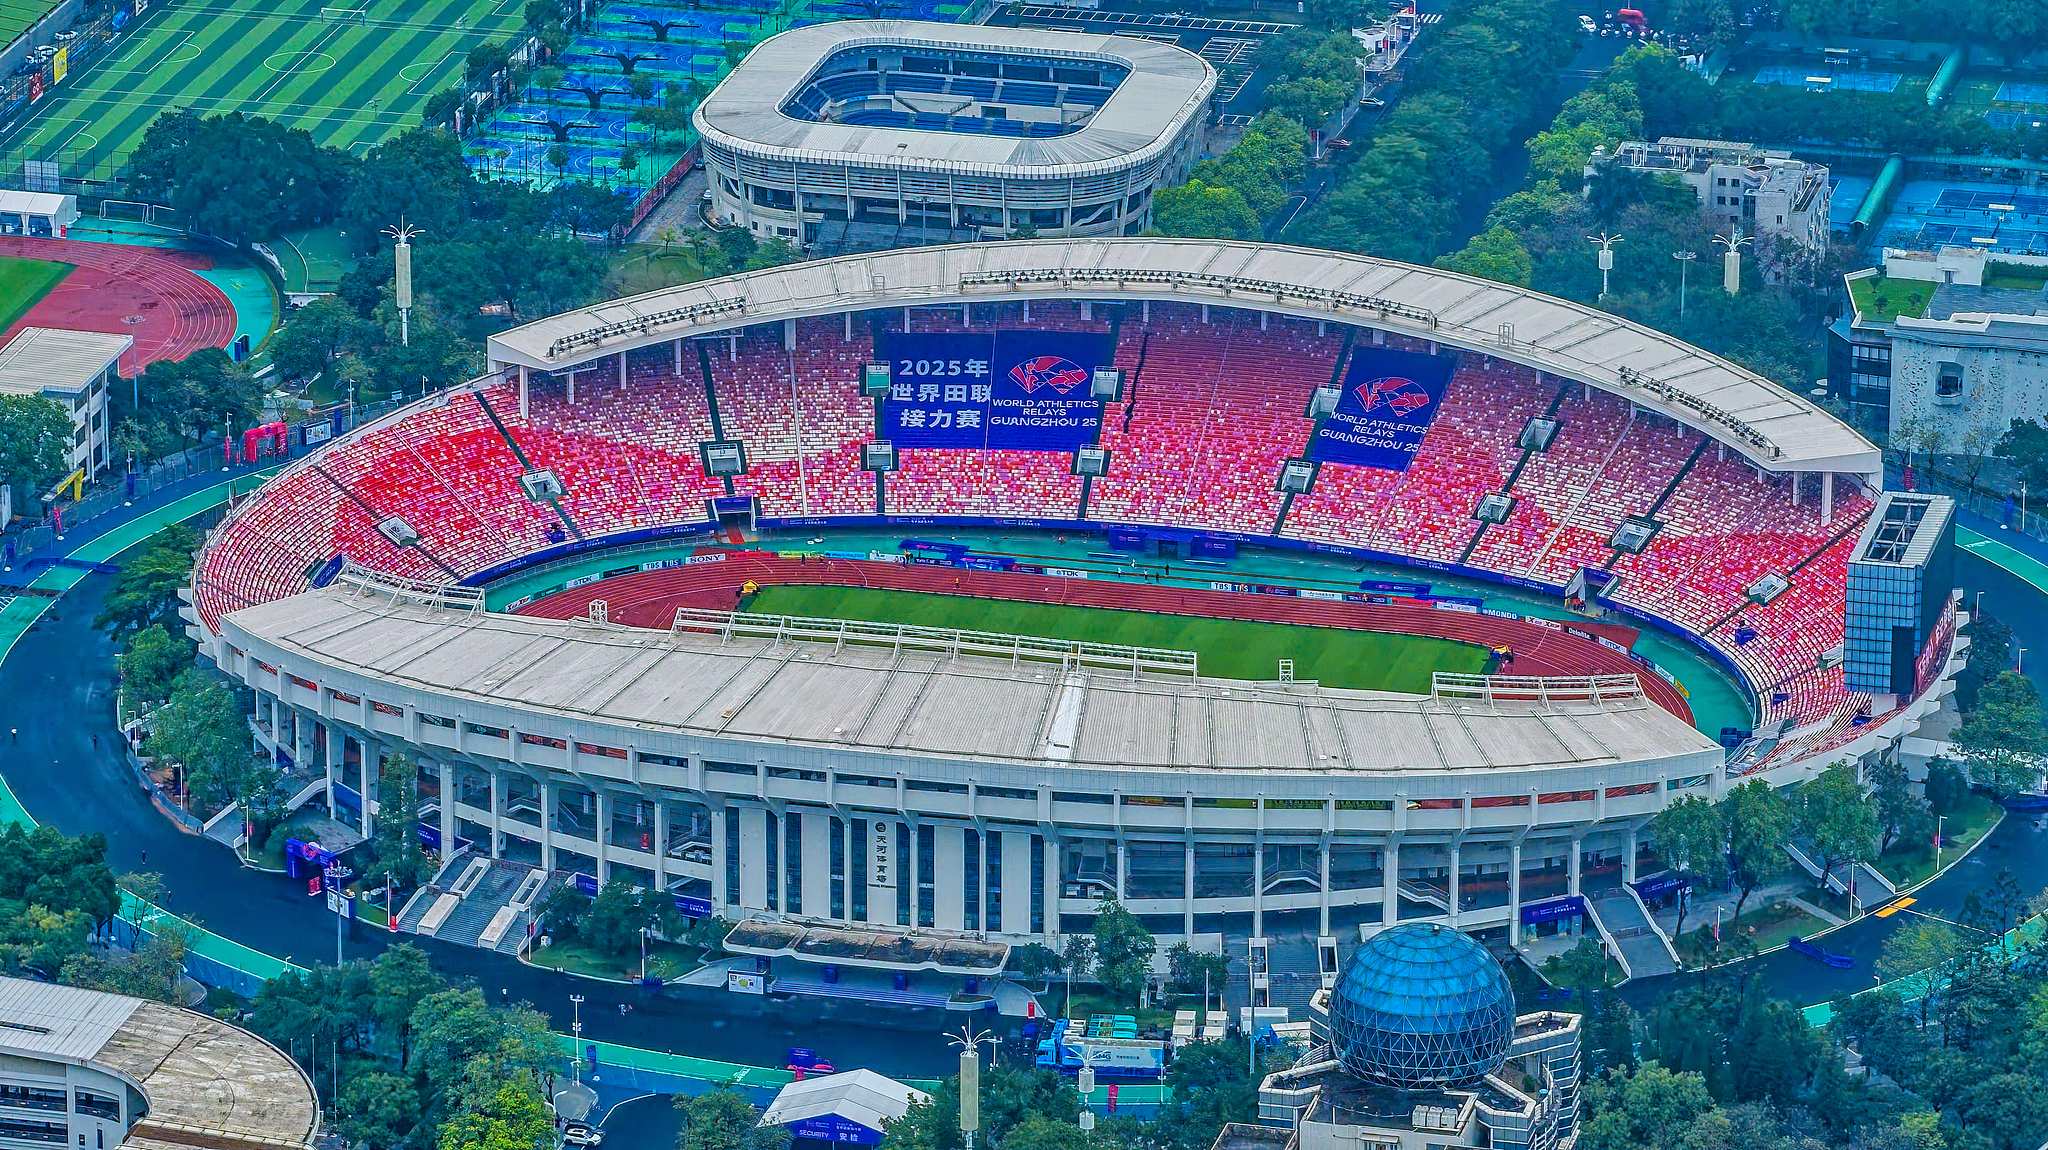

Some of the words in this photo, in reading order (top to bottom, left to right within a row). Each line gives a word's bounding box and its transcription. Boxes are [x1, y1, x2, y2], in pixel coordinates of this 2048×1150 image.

[899, 359, 989, 377] 2025年
[890, 383, 991, 402] 世界田联
[992, 399, 1035, 407] WORLD
[1036, 400, 1099, 408] ATHLETICS
[1023, 408, 1067, 416] RELAYS
[900, 408, 981, 428] 接力赛
[990, 416, 1078, 426] GUANGZHOU
[1082, 418, 1098, 426] 25
[1352, 425, 1396, 438] RELAYS
[1369, 419, 1429, 435] ATHLETICS
[1319, 428, 1404, 450] GUANGZHOU
[1403, 443, 1420, 452] 25
[689, 555, 721, 563] SONY
[1061, 569, 1079, 577] TDK
[1234, 584, 1249, 592] TS
[1488, 609, 1517, 620] MONDO
[799, 1129, 829, 1138] SECURITY
